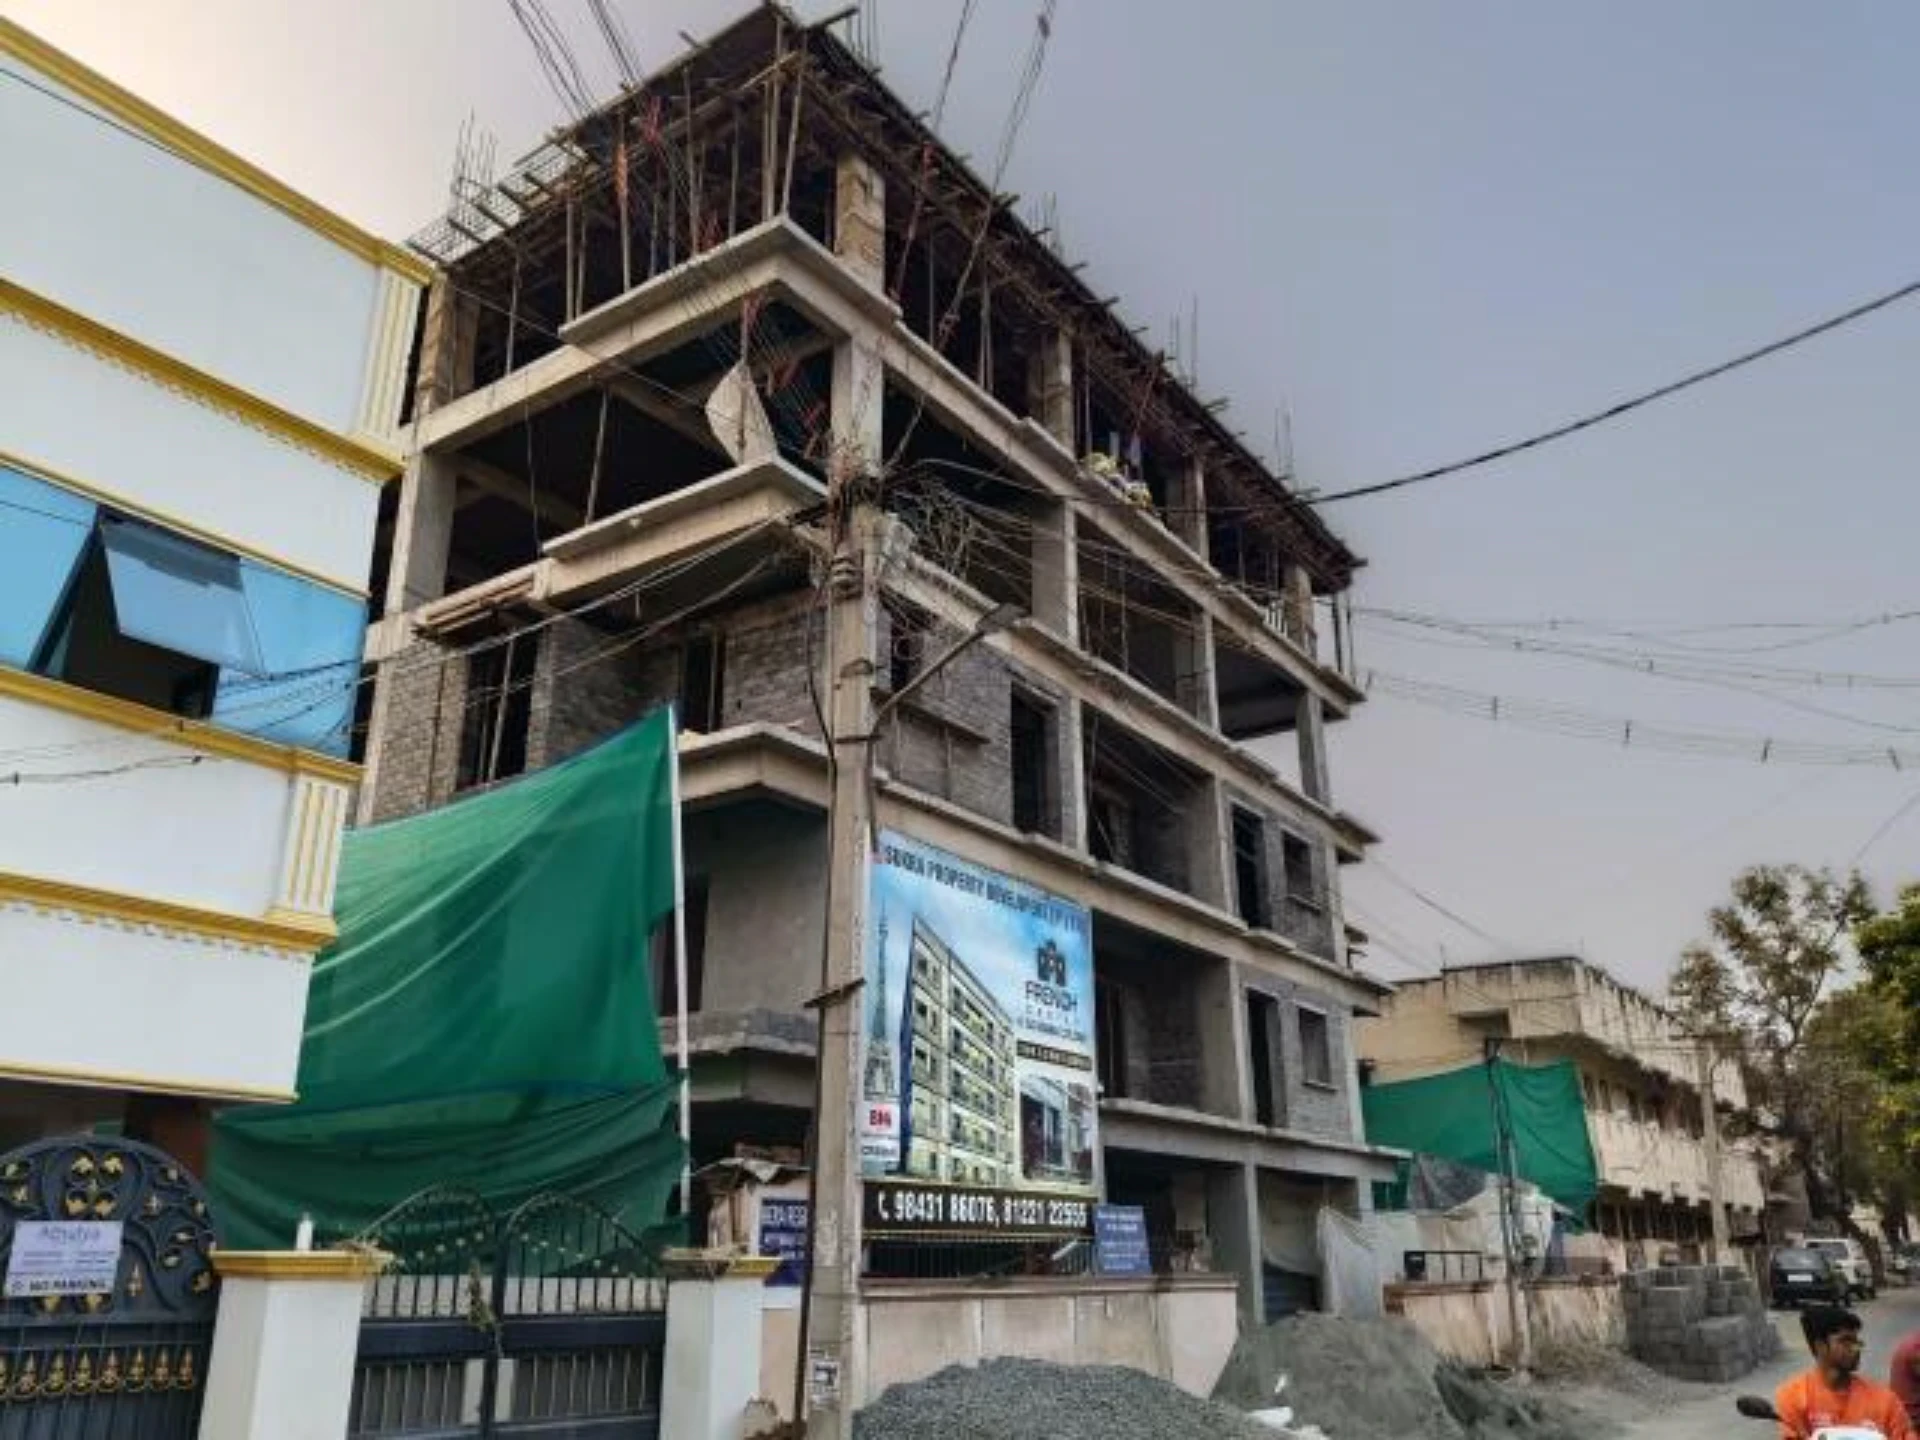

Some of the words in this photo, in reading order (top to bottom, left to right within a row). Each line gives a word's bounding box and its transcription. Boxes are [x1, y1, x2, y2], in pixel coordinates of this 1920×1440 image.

[926, 861, 985, 898] PROPERTY
[1025, 980, 1077, 1013] FRENCH
[895, 1191, 943, 1222] 98431
